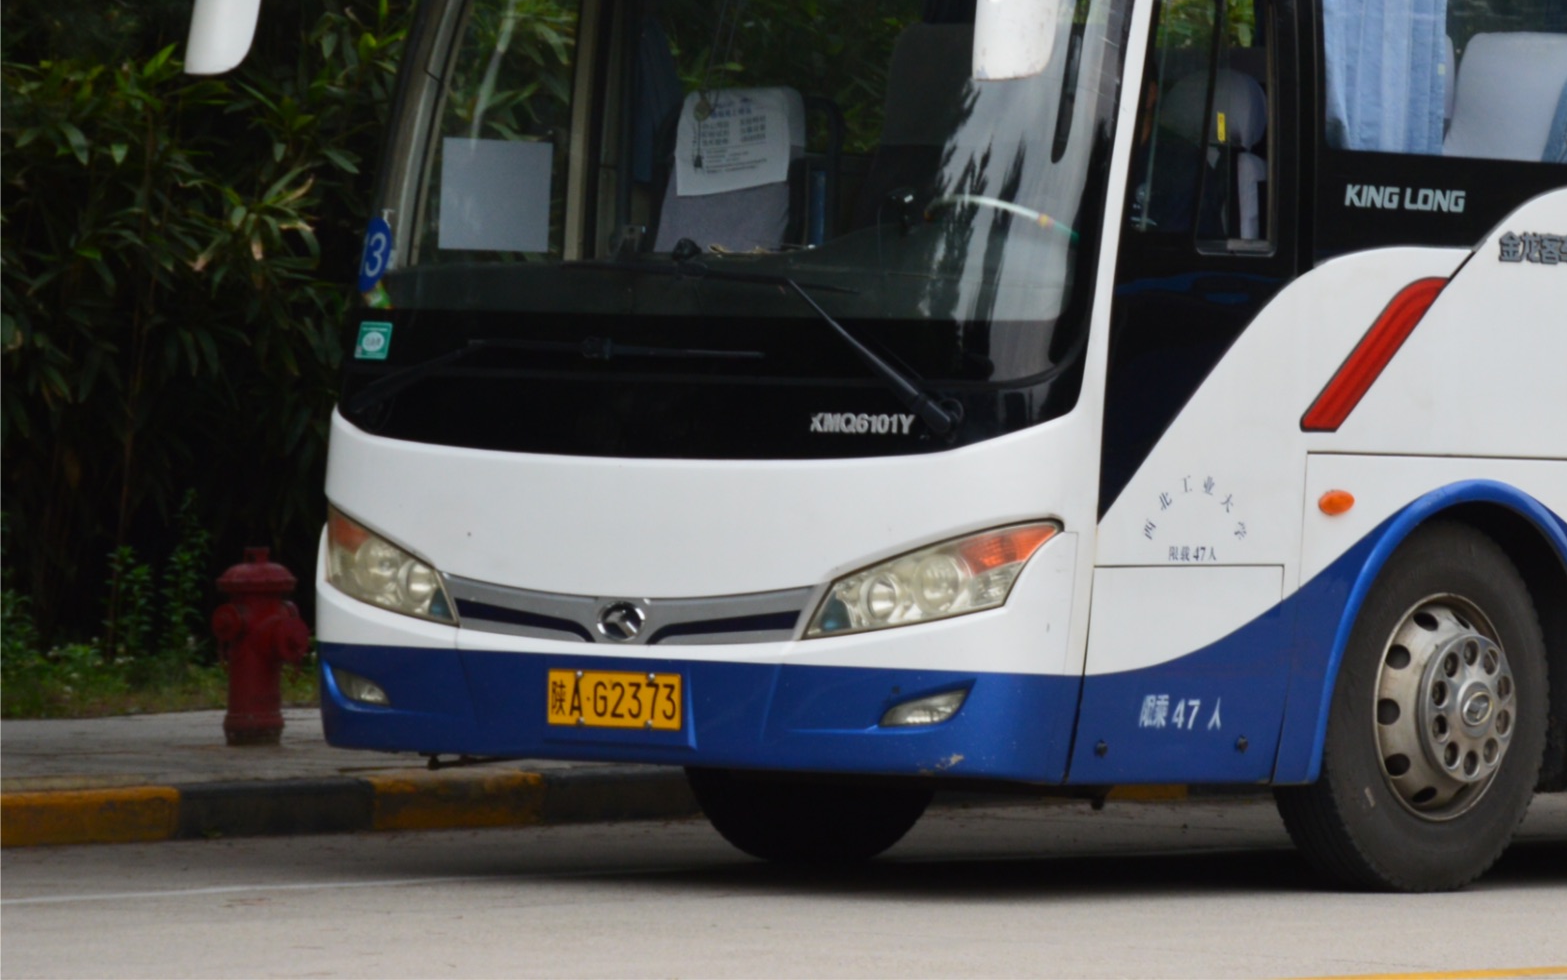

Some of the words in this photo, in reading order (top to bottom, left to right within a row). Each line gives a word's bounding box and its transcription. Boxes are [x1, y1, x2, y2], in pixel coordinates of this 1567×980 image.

[1345, 184, 1400, 209] KING
[1404, 187, 1466, 212] LONG
[810, 412, 916, 435] XMQ6101Y
